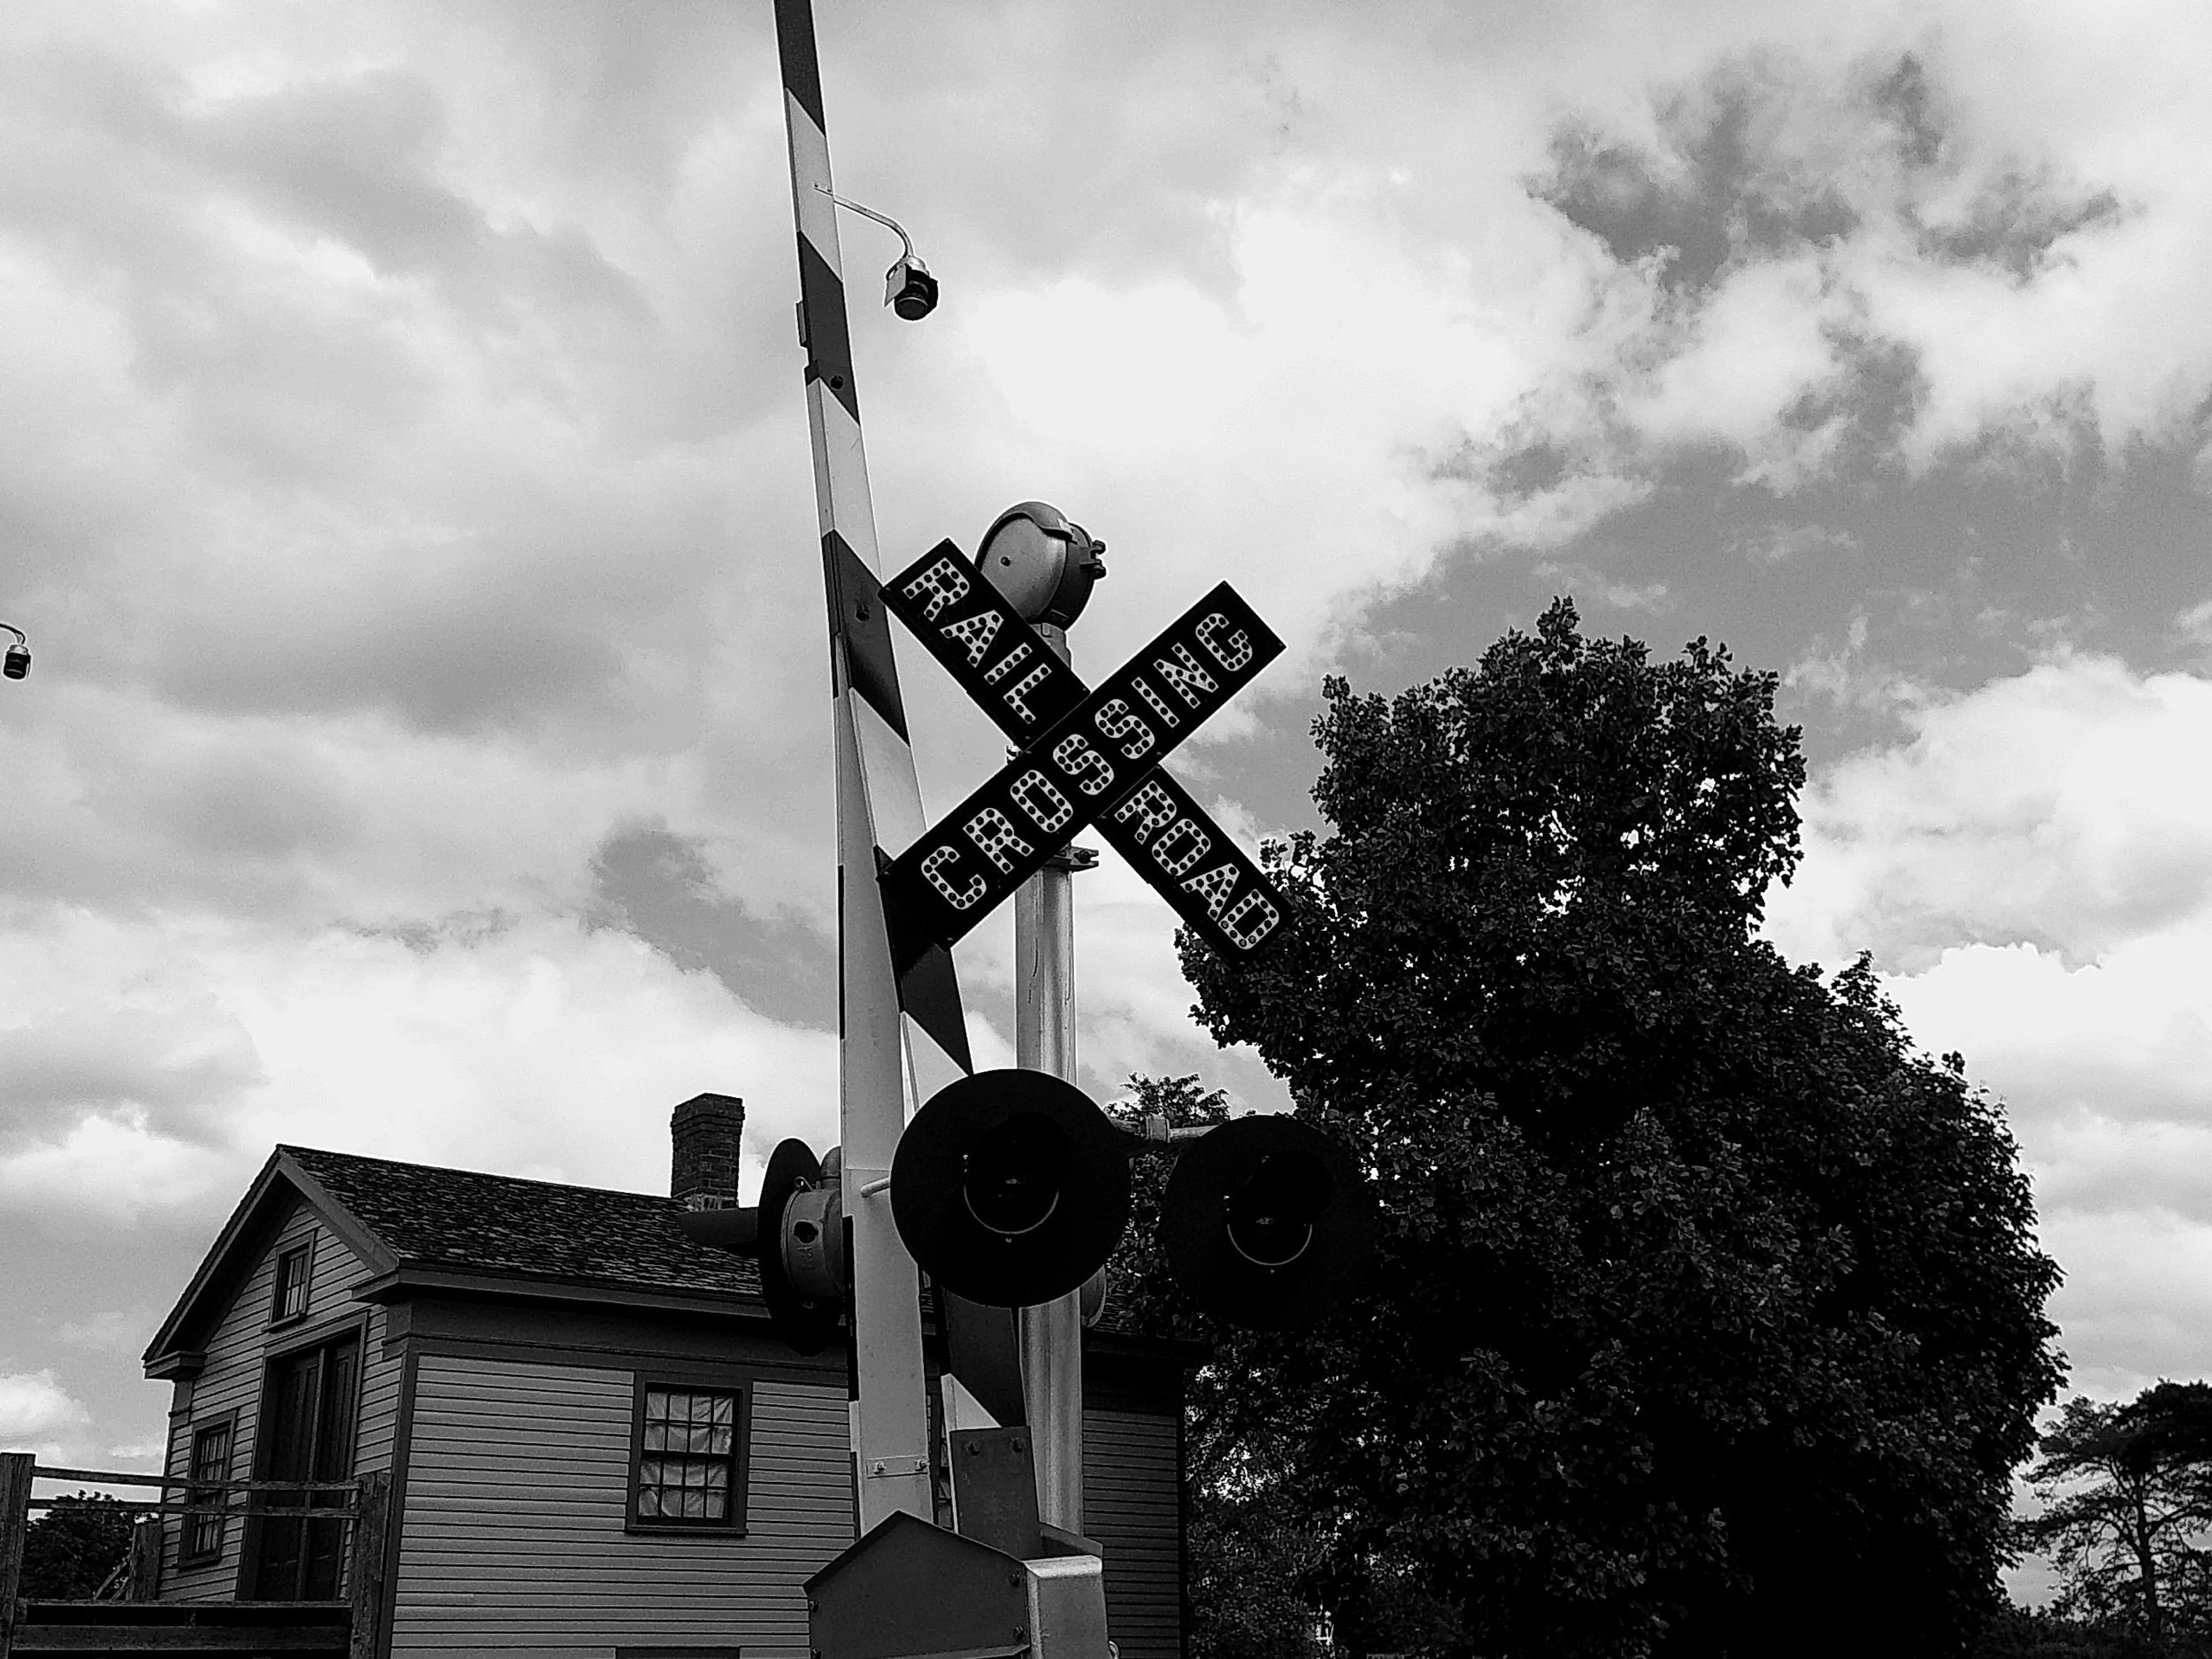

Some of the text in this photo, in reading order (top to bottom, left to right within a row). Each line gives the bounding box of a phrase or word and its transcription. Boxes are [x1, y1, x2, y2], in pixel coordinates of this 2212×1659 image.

[902, 557, 1053, 724] RAIL
[921, 613, 1253, 910] CROSSING
[1115, 780, 1279, 949] ROAD
